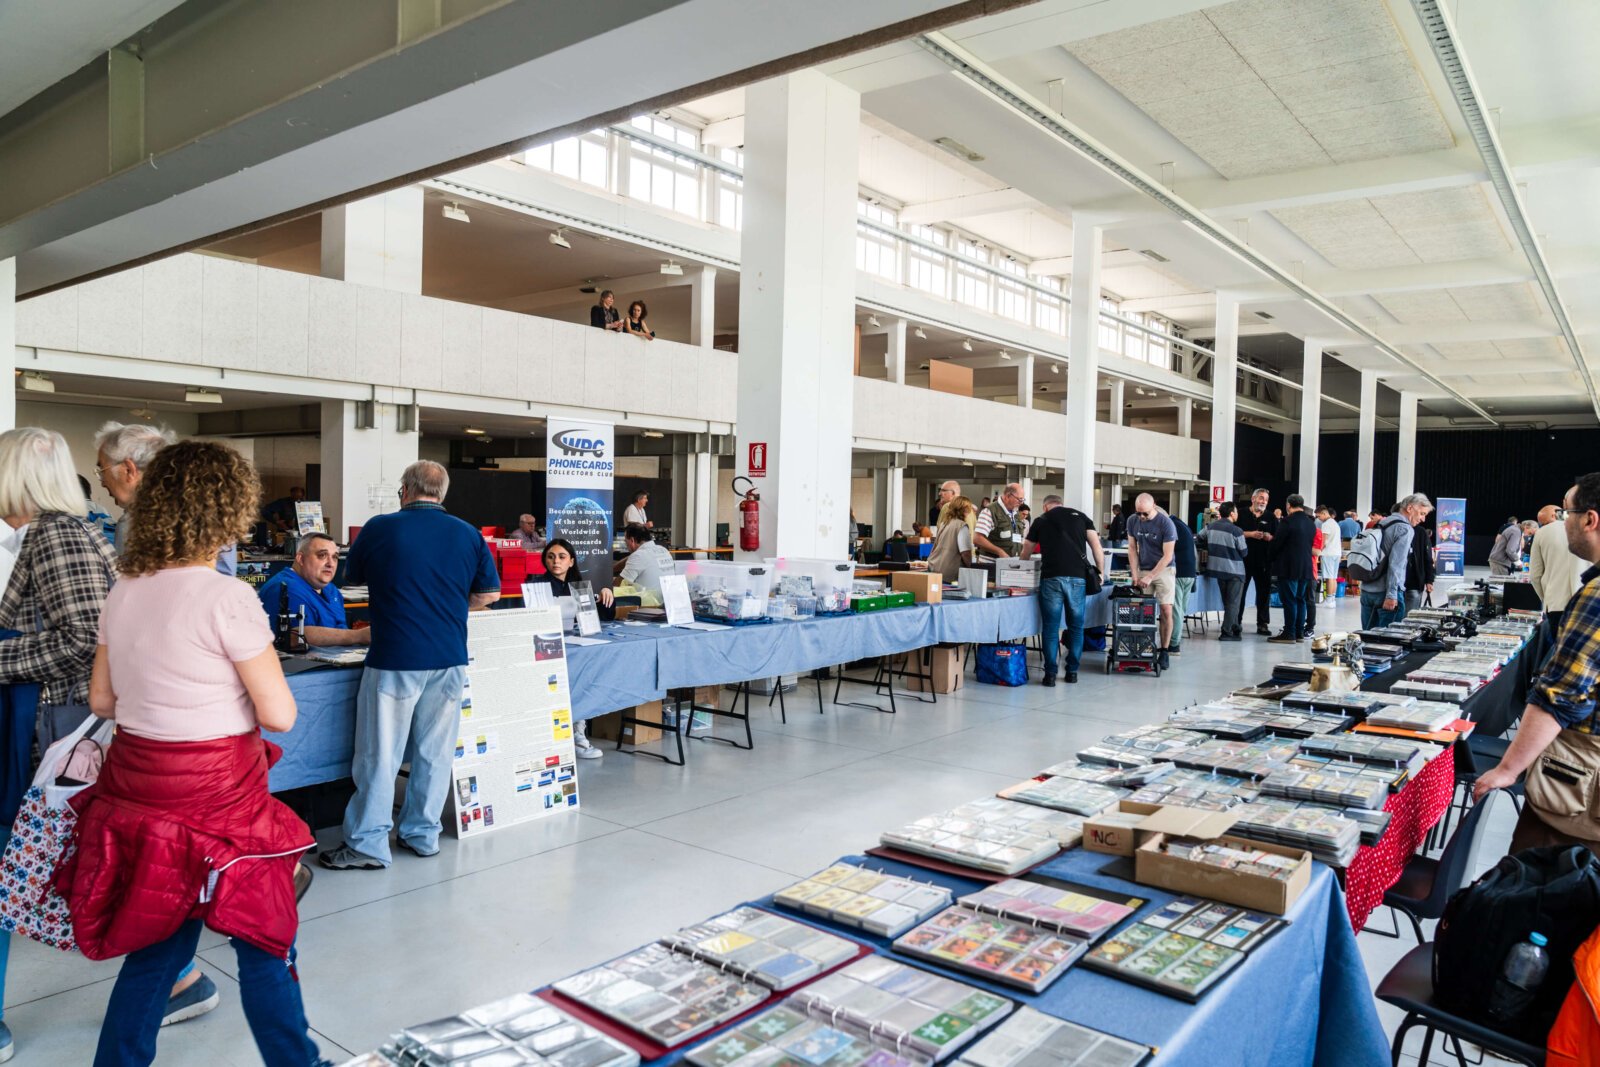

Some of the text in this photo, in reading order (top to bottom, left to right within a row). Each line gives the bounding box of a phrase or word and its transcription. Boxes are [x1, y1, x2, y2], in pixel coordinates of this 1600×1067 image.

[562, 437, 605, 458] WPC
[549, 458, 613, 471] PHONECARDS
[1094, 830, 1117, 846] NC
